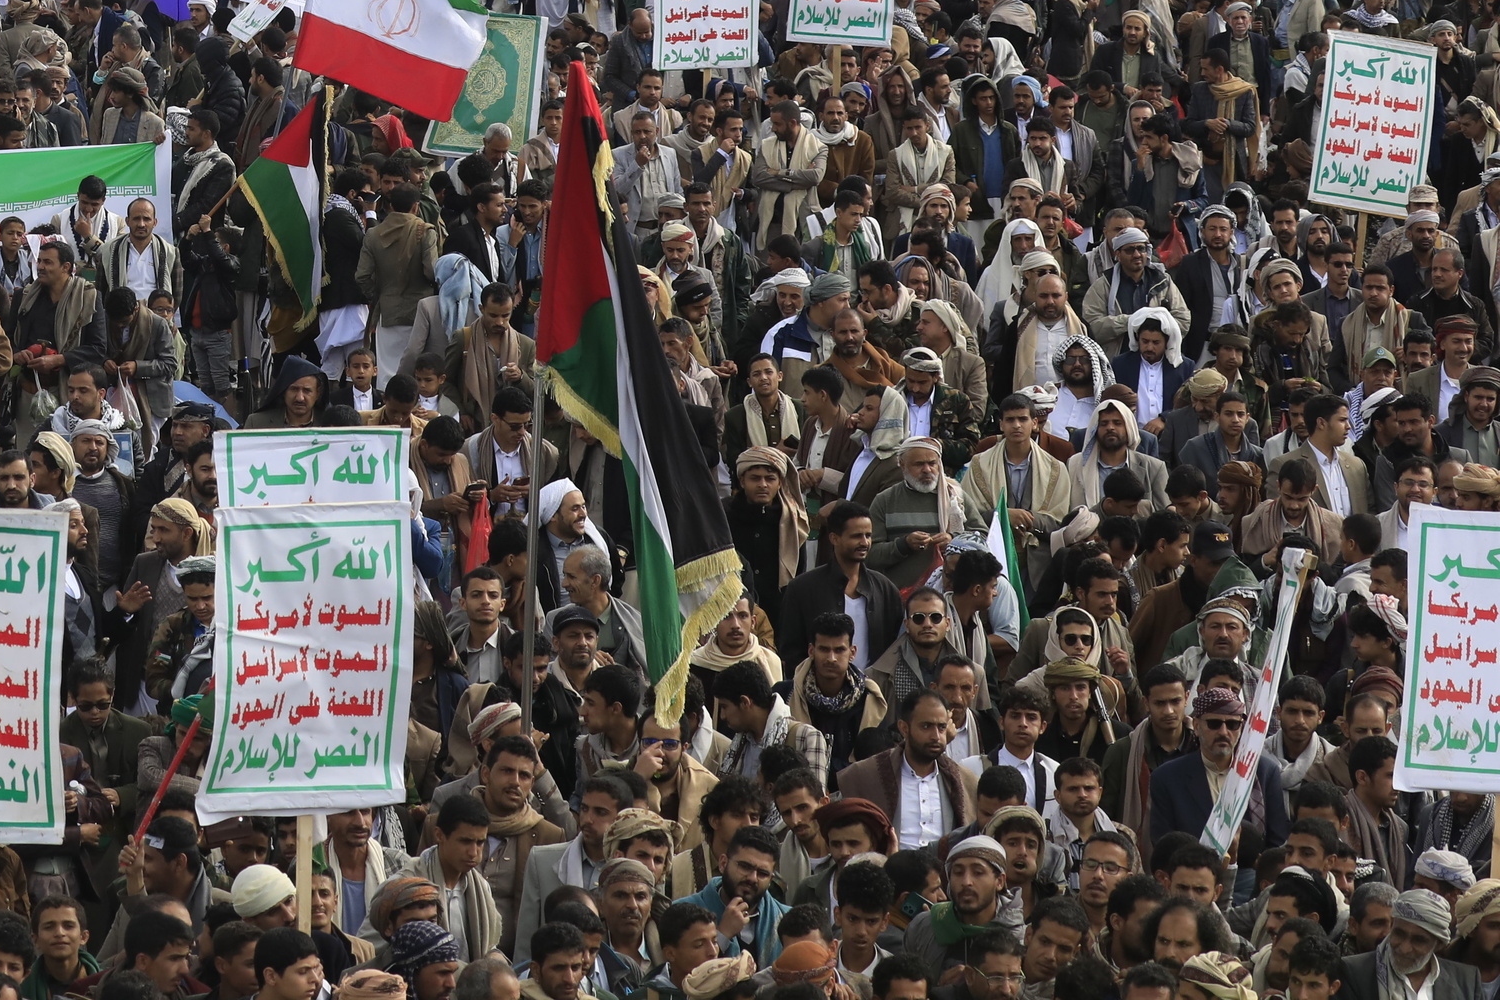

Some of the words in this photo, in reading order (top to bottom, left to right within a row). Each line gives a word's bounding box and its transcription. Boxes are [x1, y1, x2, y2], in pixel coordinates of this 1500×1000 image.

[797, 5, 841, 31] للإسلام
[842, 8, 882, 31] النصر
[1336, 52, 1391, 81] أكبر
[1391, 60, 1425, 85] الله
[1334, 82, 1380, 105] لأمريكا
[1383, 94, 1423, 112] الموت
[1330, 109, 1378, 136] لإسرائيل
[1381, 121, 1420, 139] الموت
[1326, 138, 1360, 158] اليهود
[1363, 142, 1383, 161] على
[1388, 143, 1418, 165] اللعنة
[1321, 161, 1369, 193] للإسلام
[1370, 169, 1414, 195] النصر
[237, 439, 329, 499] أكبر
[333, 444, 390, 484] الله
[235, 532, 331, 597] أكبر
[333, 536, 392, 579] الله
[237, 593, 313, 635] لأمريكا
[318, 597, 391, 631] الموت
[236, 644, 309, 686] لإسرائيل
[314, 643, 387, 678] الموت
[232, 691, 285, 730] اليهود
[289, 688, 320, 725] على
[327, 688, 383, 717] اللعنة
[219, 732, 300, 783] للإسلام
[304, 727, 379, 779] النصر
